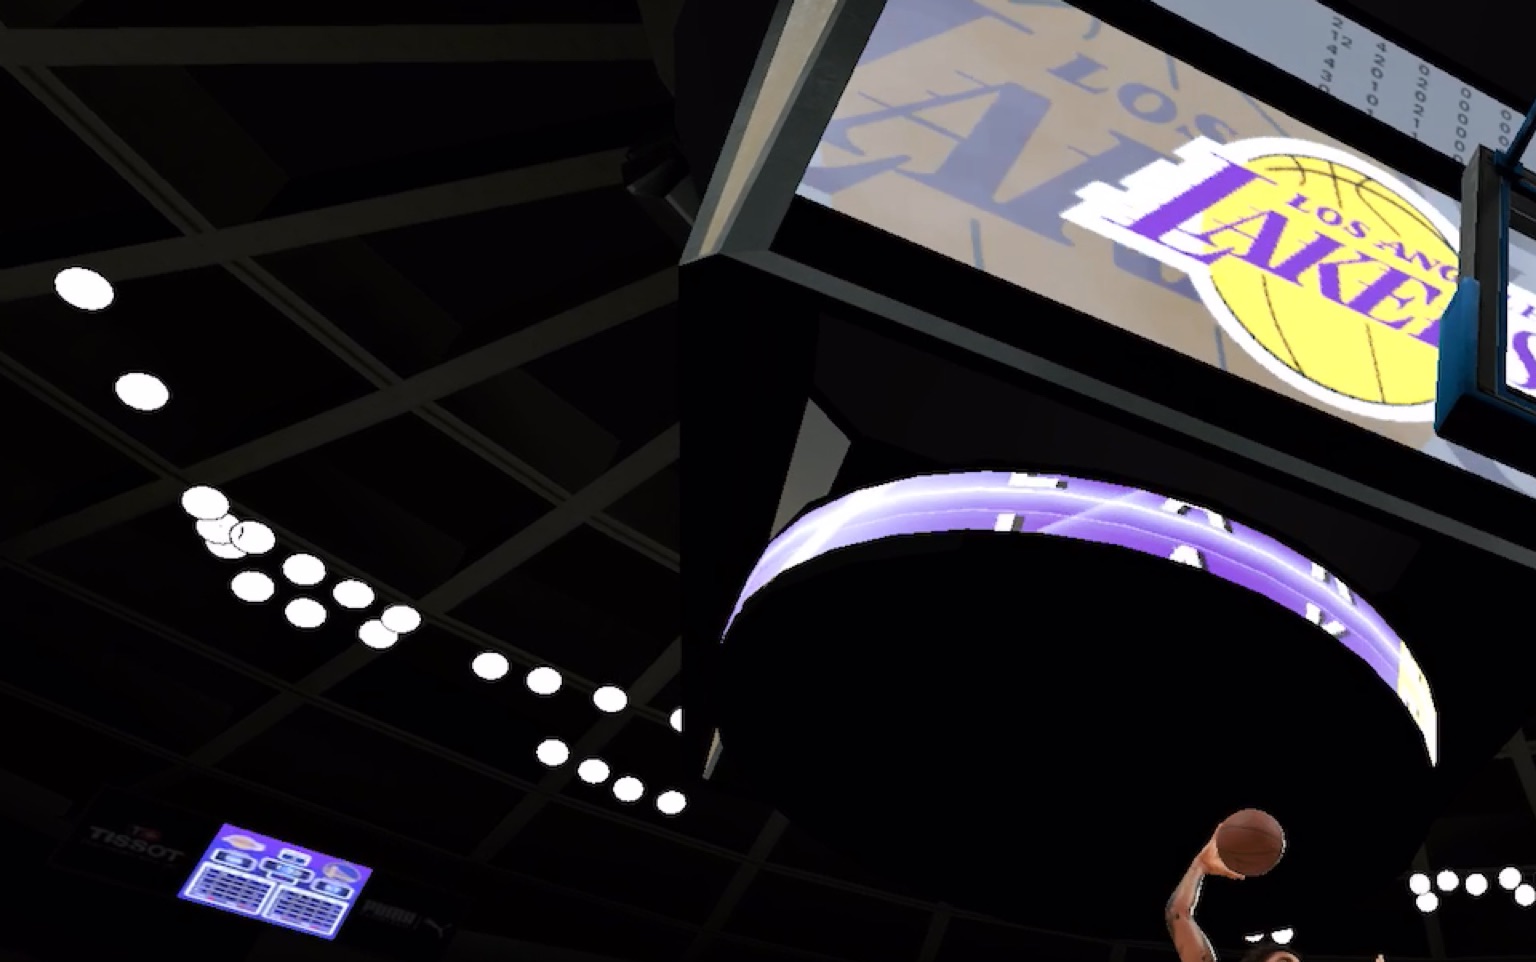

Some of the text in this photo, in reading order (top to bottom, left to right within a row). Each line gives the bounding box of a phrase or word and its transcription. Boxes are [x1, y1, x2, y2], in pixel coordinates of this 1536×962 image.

[1320, 70, 1332, 84] 3
[1366, 93, 1379, 107] 0
[1324, 57, 1336, 71] 4
[1412, 104, 1425, 118] 2
[1455, 126, 1467, 140] 0
[1326, 43, 1338, 56] 4
[1372, 67, 1384, 80] 0
[1415, 90, 1427, 104] 0
[1457, 113, 1468, 126] 0
[1332, 16, 1343, 30] 2
[1376, 42, 1387, 54] 4
[1418, 63, 1430, 76] 0
[1460, 87, 1472, 99] 0
[1500, 108, 1512, 121] 0
[1374, 53, 1386, 67] 2
[1416, 76, 1428, 90] 2
[1458, 99, 1470, 112] 0
[1499, 121, 1511, 135] 0
[1286, 194, 1371, 239] LOS
[90, 826, 184, 862] TISSOT
